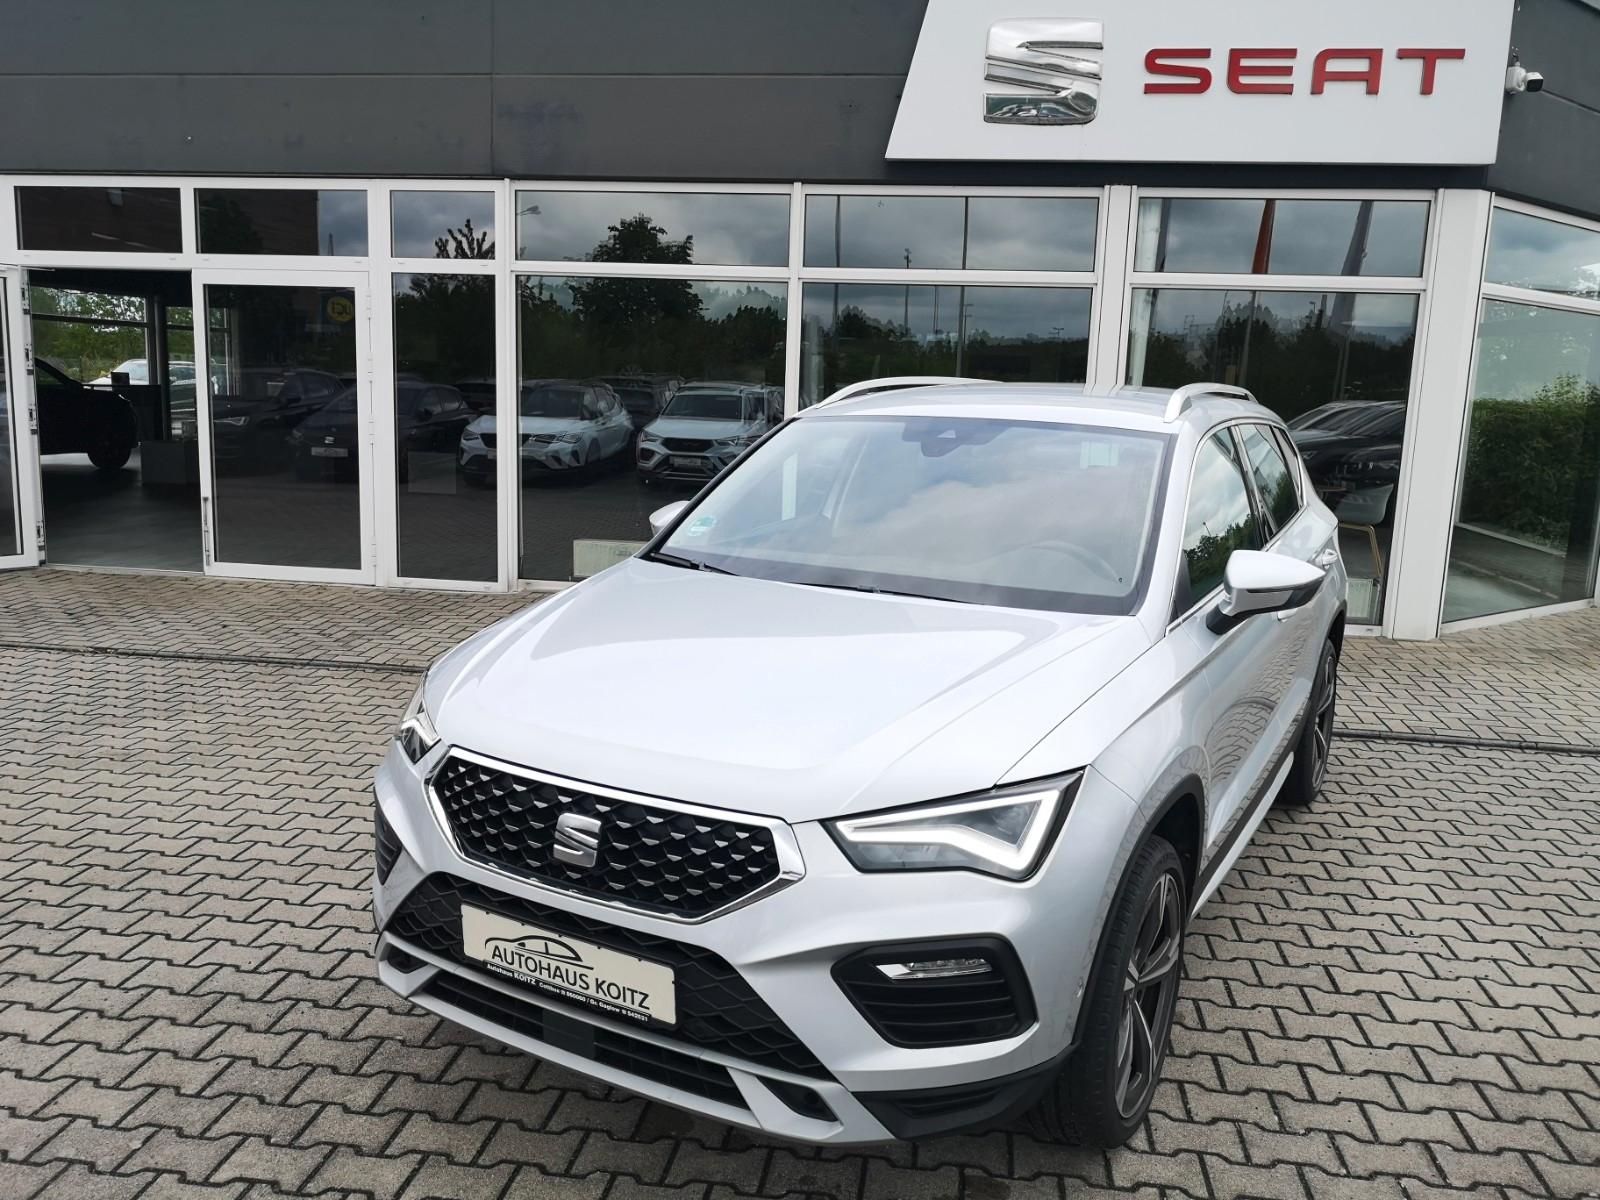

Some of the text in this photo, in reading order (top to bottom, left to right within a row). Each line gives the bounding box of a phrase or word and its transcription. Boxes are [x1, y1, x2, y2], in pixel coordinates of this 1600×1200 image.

[1143, 47, 1466, 95] SEAT
[491, 945, 651, 1011] AUTOHAUS KOITZ
